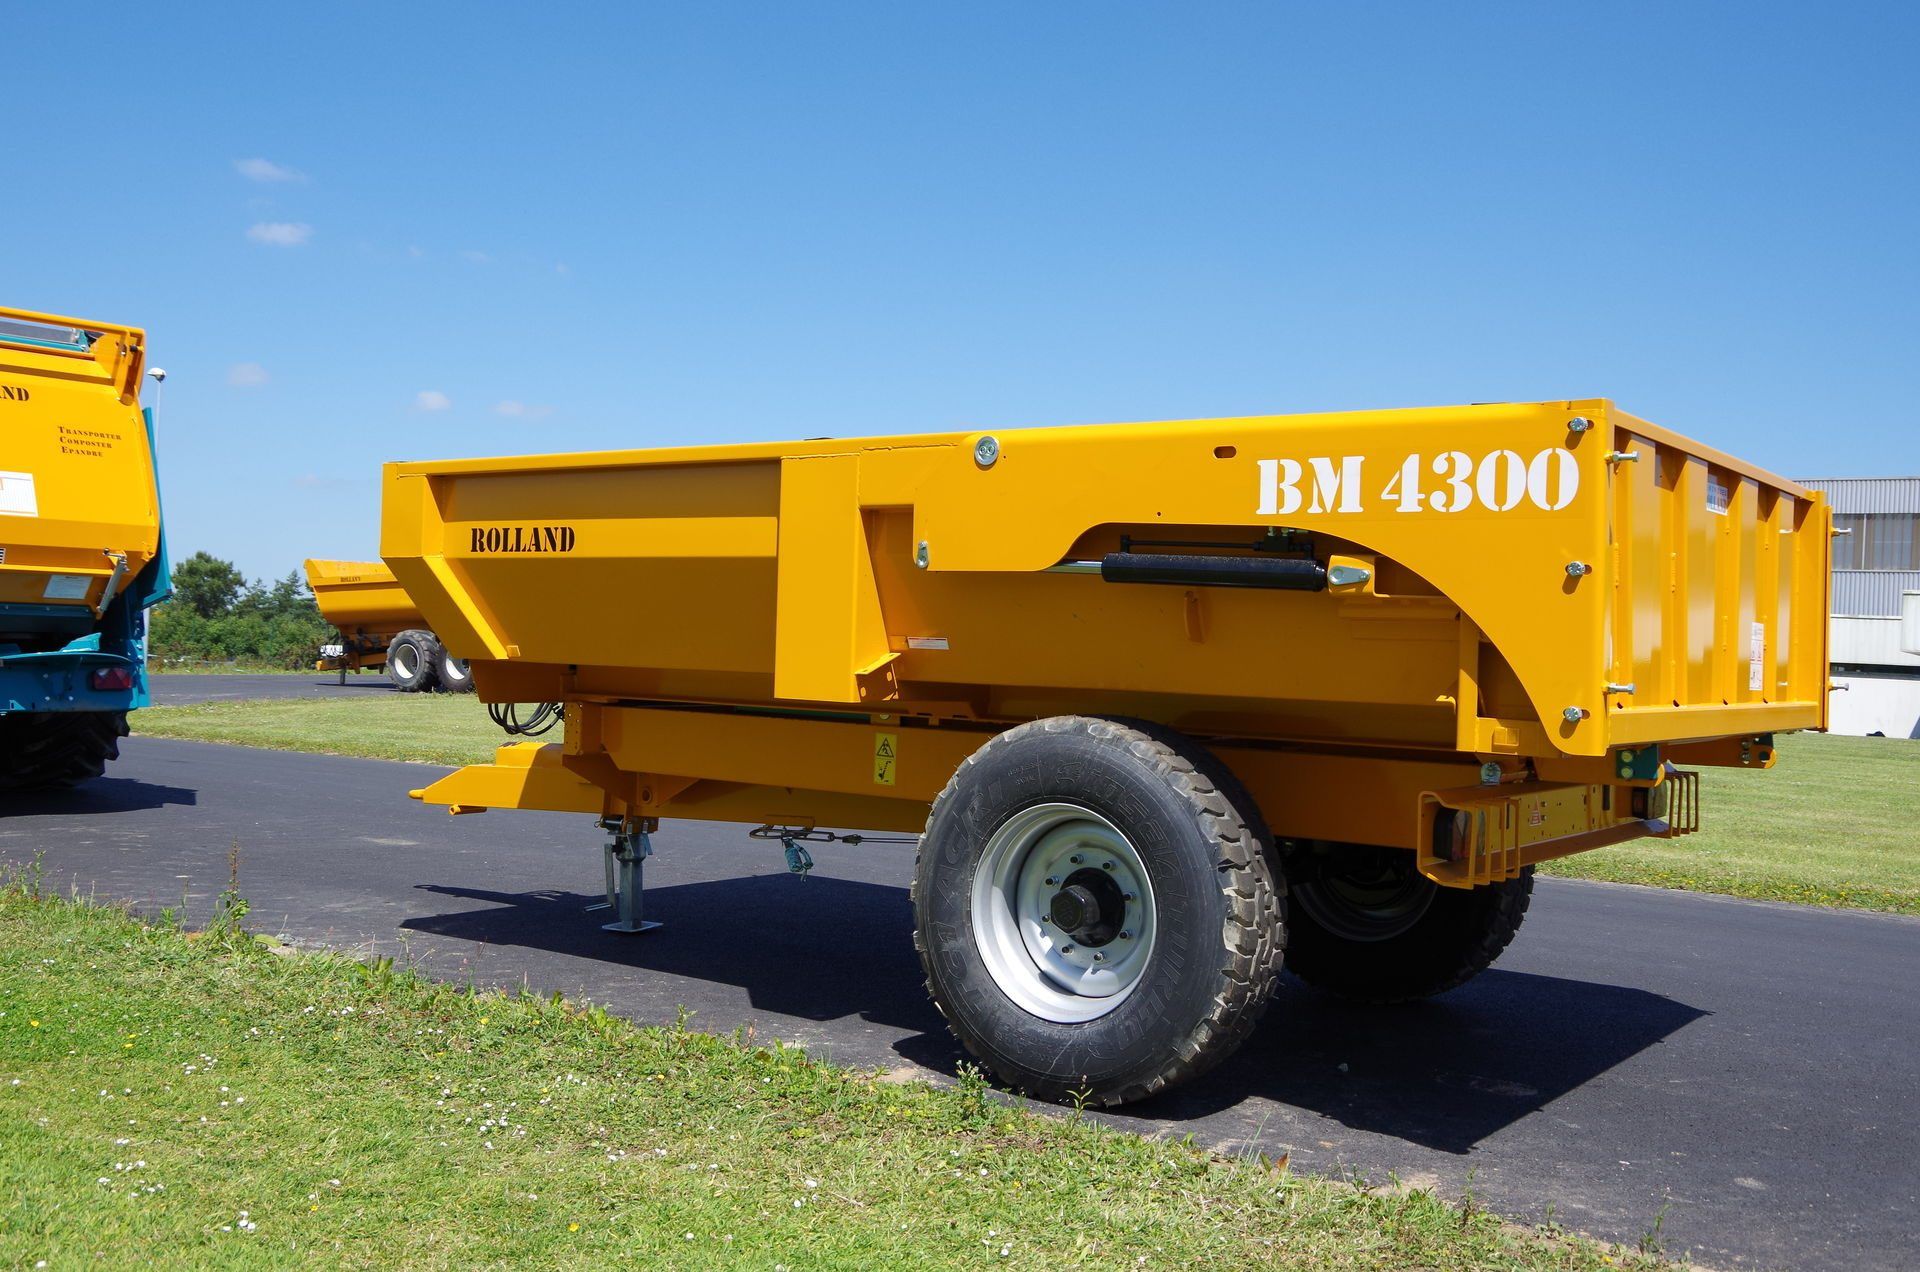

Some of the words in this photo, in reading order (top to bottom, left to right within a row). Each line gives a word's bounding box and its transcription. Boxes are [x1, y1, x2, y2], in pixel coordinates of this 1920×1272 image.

[0, 385, 29, 401] ND
[58, 426, 122, 440] TRANSPORTER
[59, 436, 113, 449] COMPOSTER
[61, 446, 104, 457] EPANDRE
[1257, 456, 1365, 514] BM
[1381, 448, 1579, 512] 4300
[471, 527, 575, 552] ROLLAND
